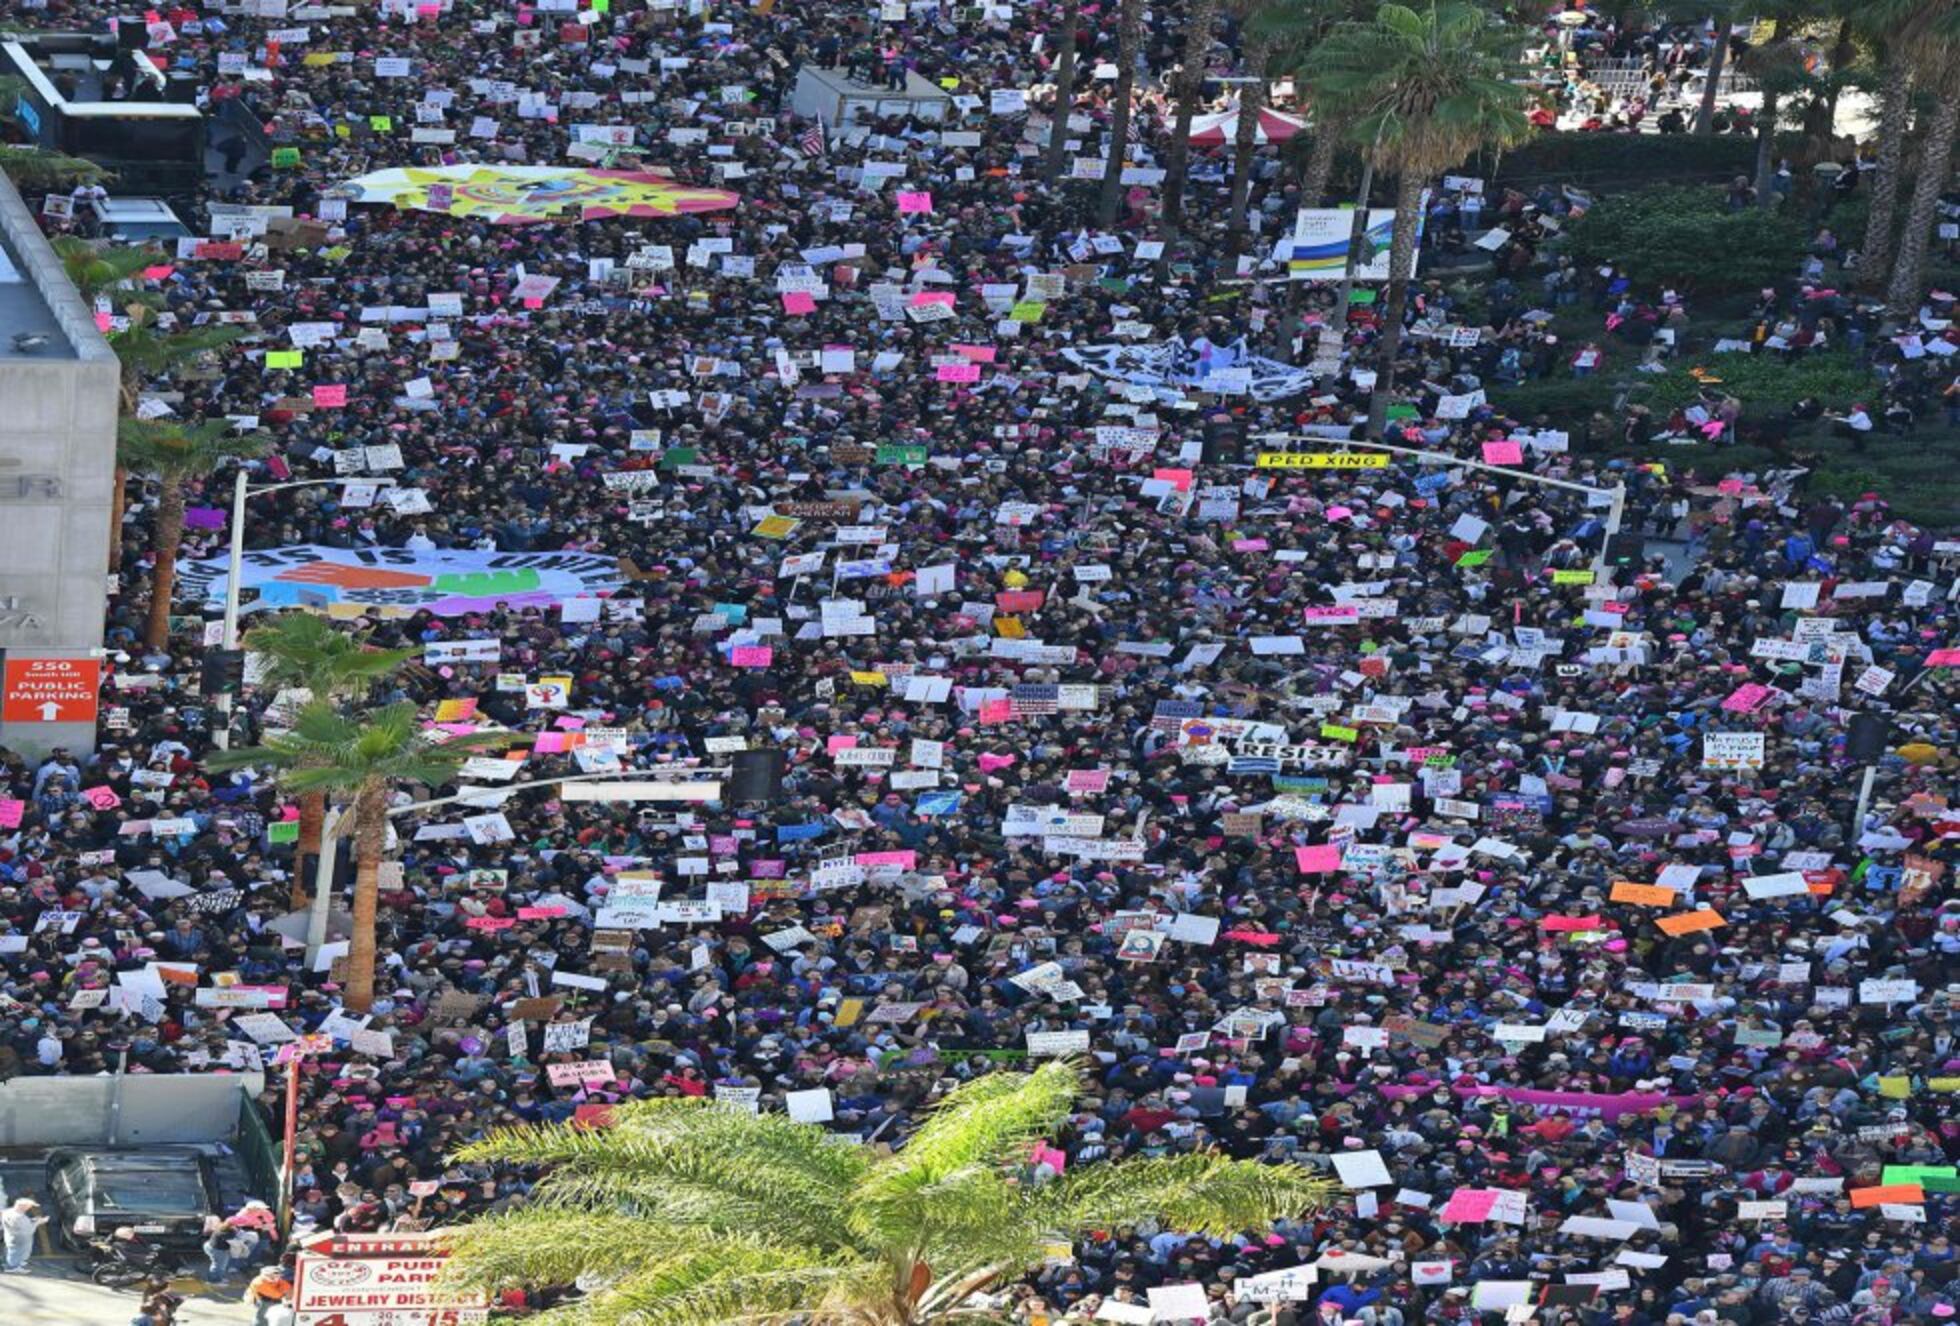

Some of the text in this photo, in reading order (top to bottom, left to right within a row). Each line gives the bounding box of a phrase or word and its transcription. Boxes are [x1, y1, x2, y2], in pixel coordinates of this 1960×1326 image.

[1269, 455, 1377, 466] PED XING
[31, 661, 72, 671] 550
[18, 682, 86, 691] PUBLIC
[9, 691, 93, 700] PARKING
[1244, 743, 1342, 760] RESIST
[1558, 1009, 1586, 1025] NO
[387, 1261, 443, 1270] PUB
[377, 1273, 438, 1283] PARK
[305, 1293, 479, 1307] JEWELRY DISTCT
